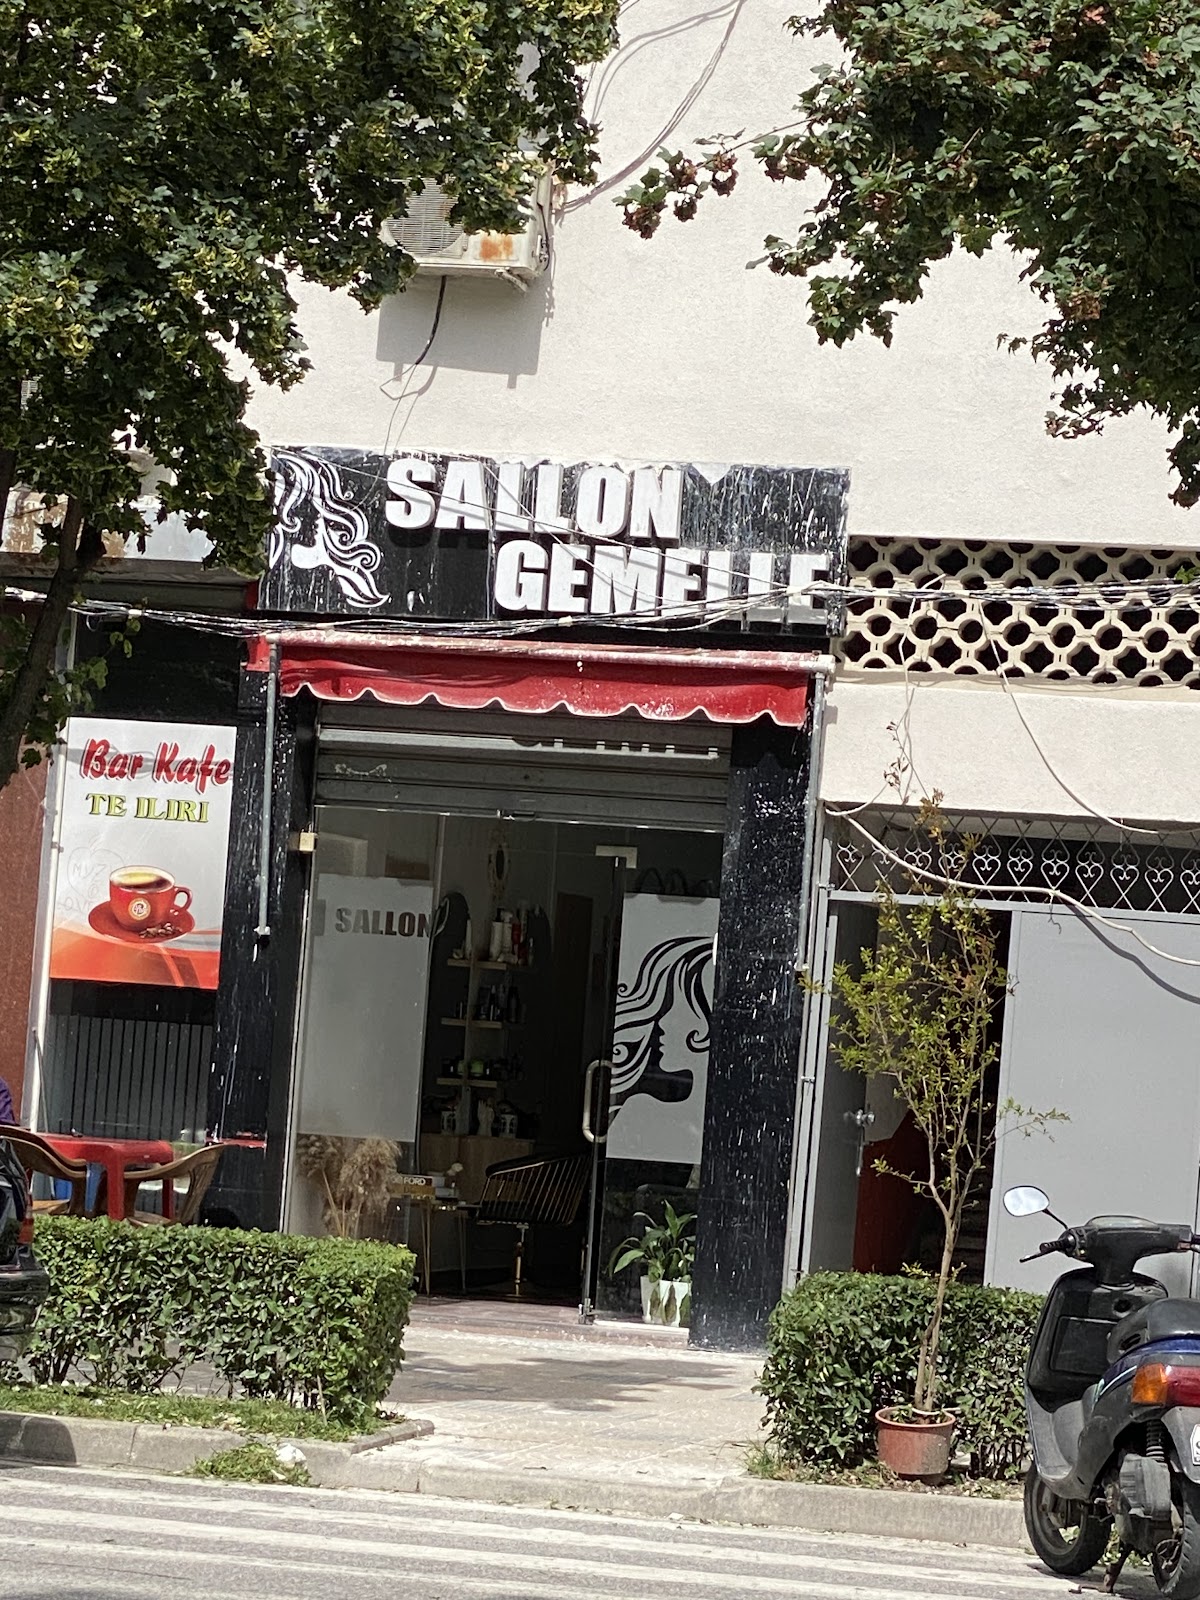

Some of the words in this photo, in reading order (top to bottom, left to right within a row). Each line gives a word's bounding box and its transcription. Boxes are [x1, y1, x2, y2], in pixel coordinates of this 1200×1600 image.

[384, 457, 683, 540] SALLON
[494, 539, 829, 625] GEMELLE
[80, 738, 144, 782] Bar
[152, 741, 232, 794] Kafe
[86, 792, 128, 818] TE
[134, 796, 210, 824] ILIRI
[335, 907, 432, 938] SALLON
